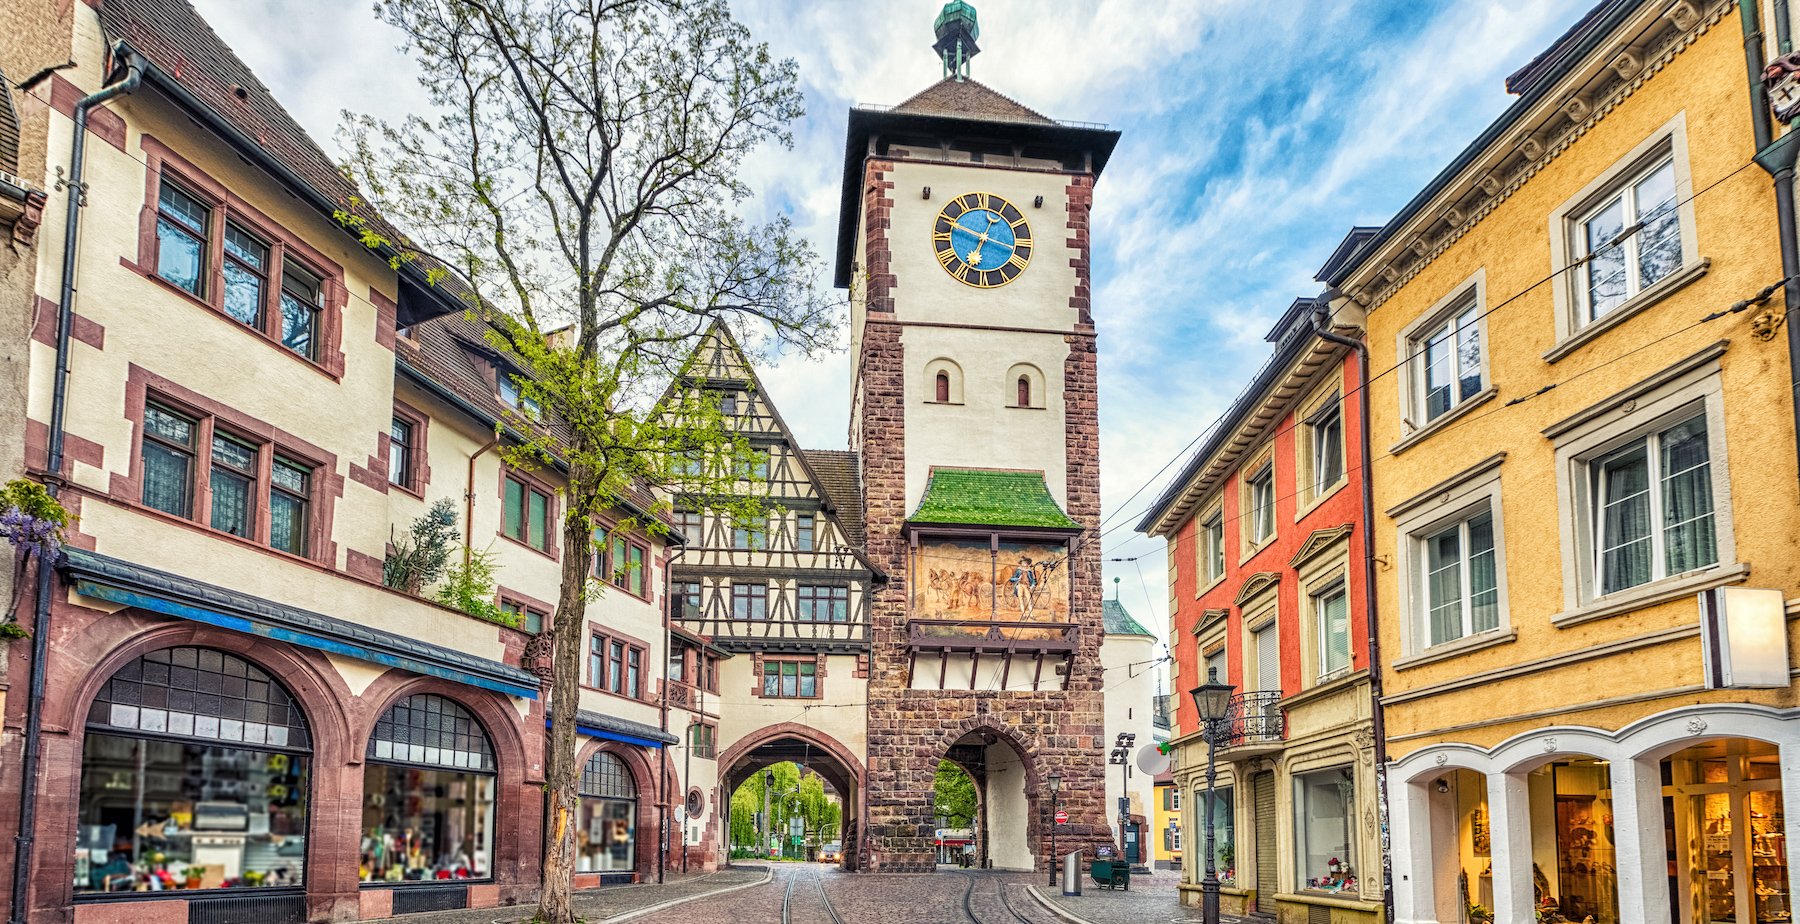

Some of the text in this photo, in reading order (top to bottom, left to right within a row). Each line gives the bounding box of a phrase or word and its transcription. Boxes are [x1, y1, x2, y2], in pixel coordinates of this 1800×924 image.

[955, 197, 969, 212] XI
[977, 194, 988, 208] XII
[999, 202, 1007, 213] I
[1011, 218, 1026, 228] II
[935, 231, 950, 240] IX
[1016, 238, 1031, 247] III
[938, 248, 957, 266] VIII
[1010, 254, 1028, 270] IIII
[954, 263, 969, 280] VII
[980, 271, 988, 286] VI
[1000, 269, 1010, 282] V
